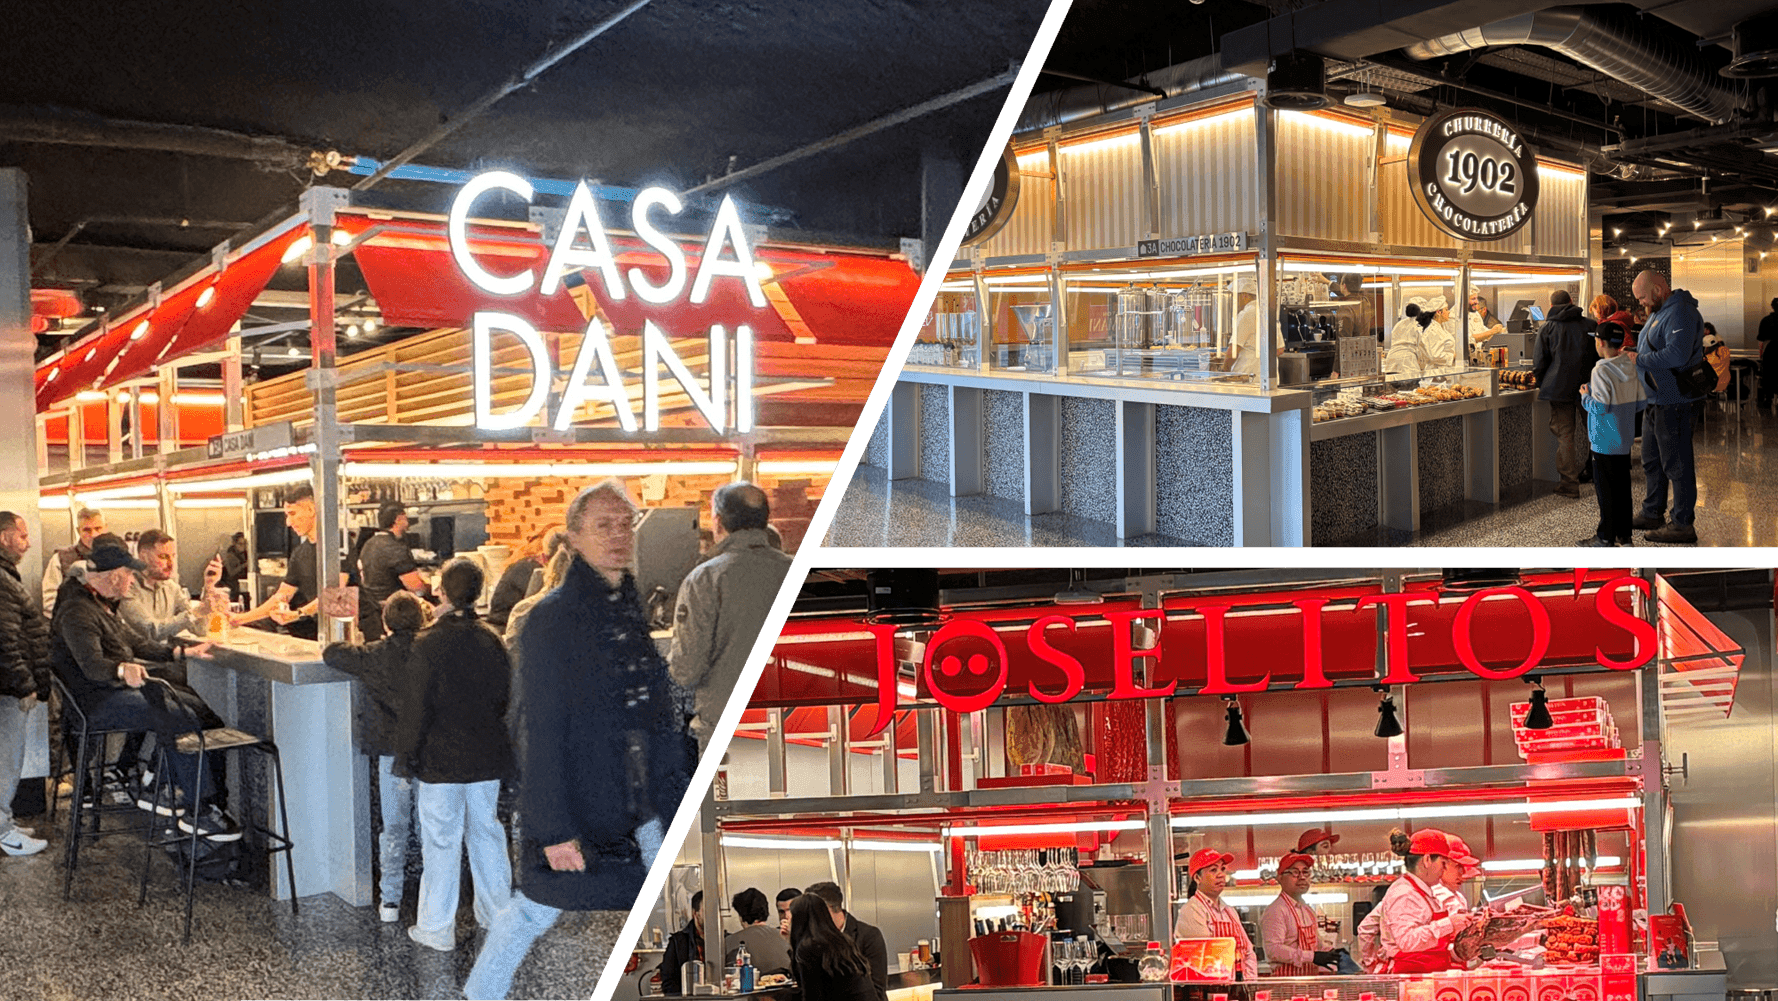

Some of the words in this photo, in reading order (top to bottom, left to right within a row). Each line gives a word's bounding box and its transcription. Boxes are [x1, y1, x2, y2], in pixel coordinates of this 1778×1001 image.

[1446, 149, 1515, 194] 1902
[448, 170, 768, 308] CASA
[1219, 235, 1241, 249] 1902
[473, 311, 753, 436] DANI
[866, 567, 1658, 738] JOSELITO'S
